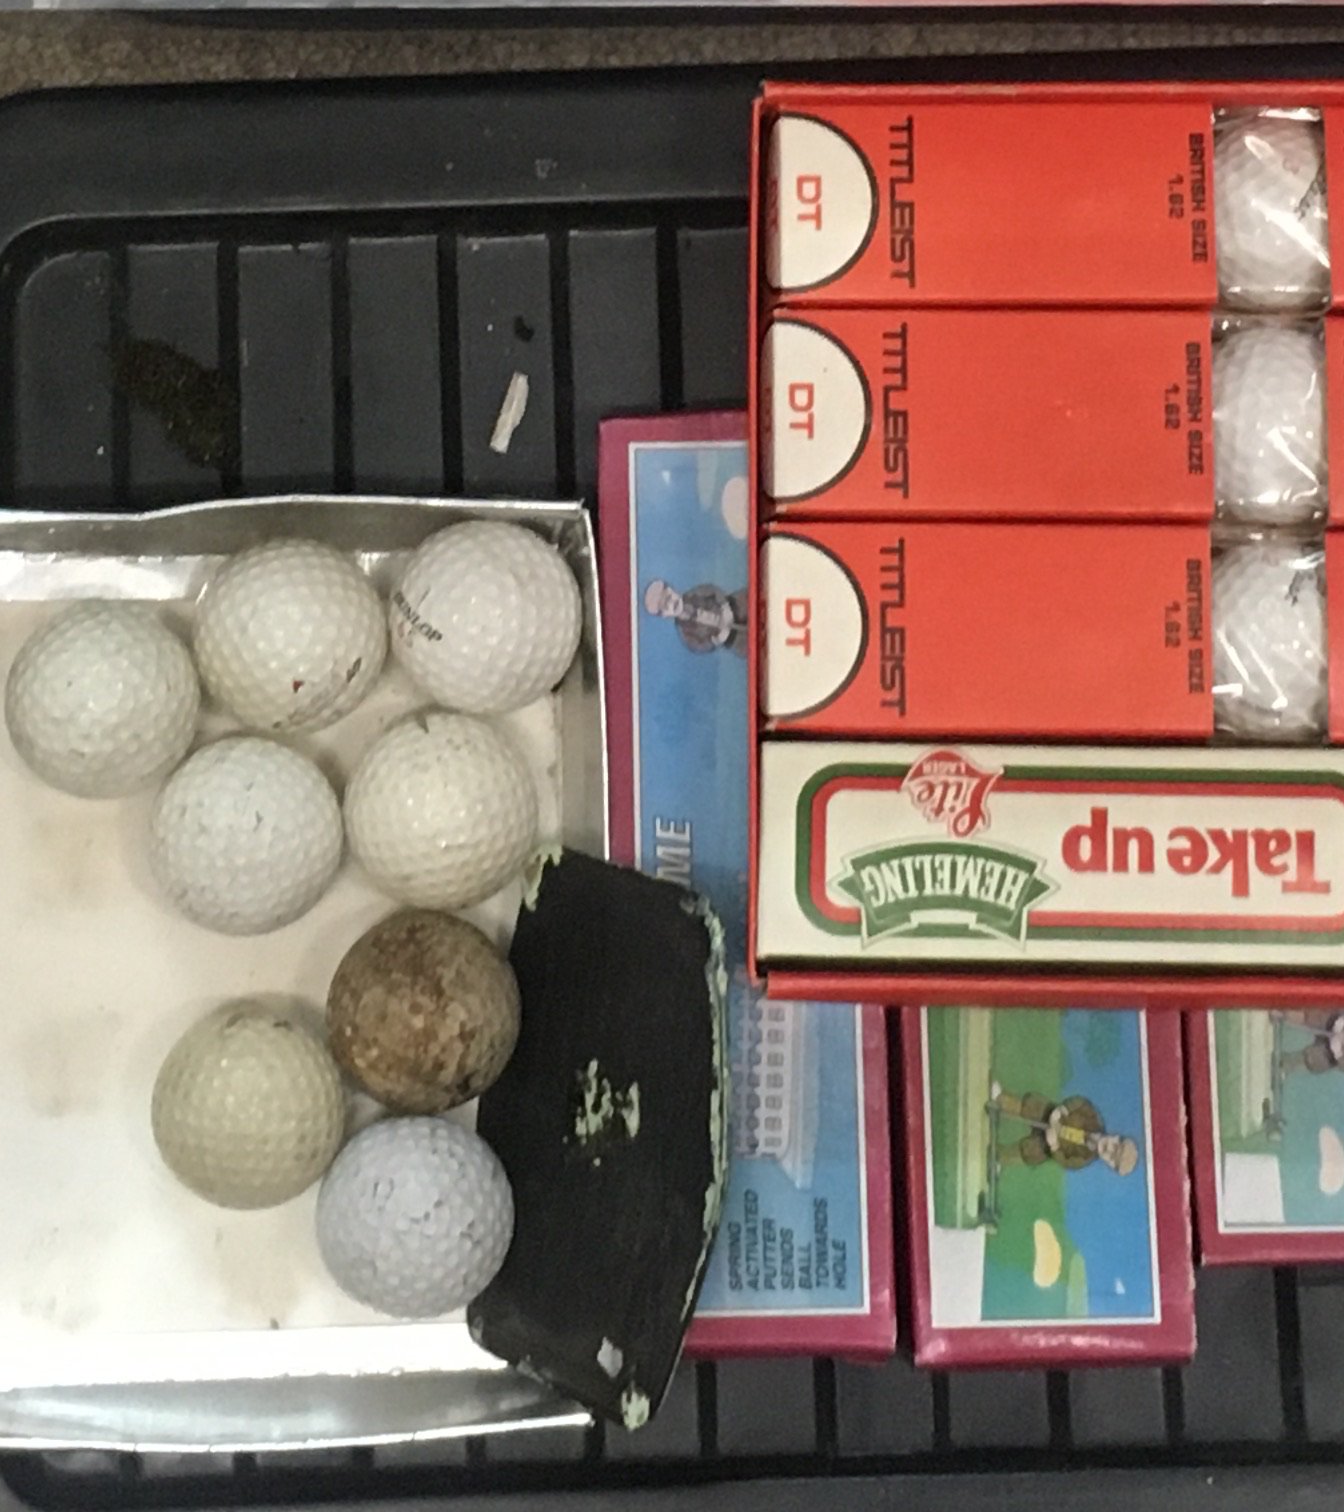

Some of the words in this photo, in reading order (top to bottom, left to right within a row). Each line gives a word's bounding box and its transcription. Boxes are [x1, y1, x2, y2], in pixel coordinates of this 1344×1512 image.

[796, 175, 822, 231] DT
[889, 115, 915, 289] TITLEIST
[1189, 133, 1205, 212] BRITISH
[1191, 219, 1208, 263] SIZE
[789, 382, 814, 440] DT
[882, 322, 909, 500] TITLEIST
[1186, 342, 1202, 422] BRITISH
[1188, 429, 1204, 475] SIZE
[785, 599, 811, 657] DT
[880, 537, 905, 717] TITLEIST
[1186, 559, 1203, 641] BRITISH
[1188, 648, 1204, 694] SIZE
[655, 816, 692, 888] ME
[1061, 806, 1155, 874] up
[1166, 826, 1331, 898] Take
[861, 854, 1029, 909] HEMELING
[744, 1189, 759, 1291] ACTIVATED
[762, 1218, 777, 1290] PUTTER
[798, 1241, 813, 1290] BALL
[832, 1239, 846, 1290] HOLE
